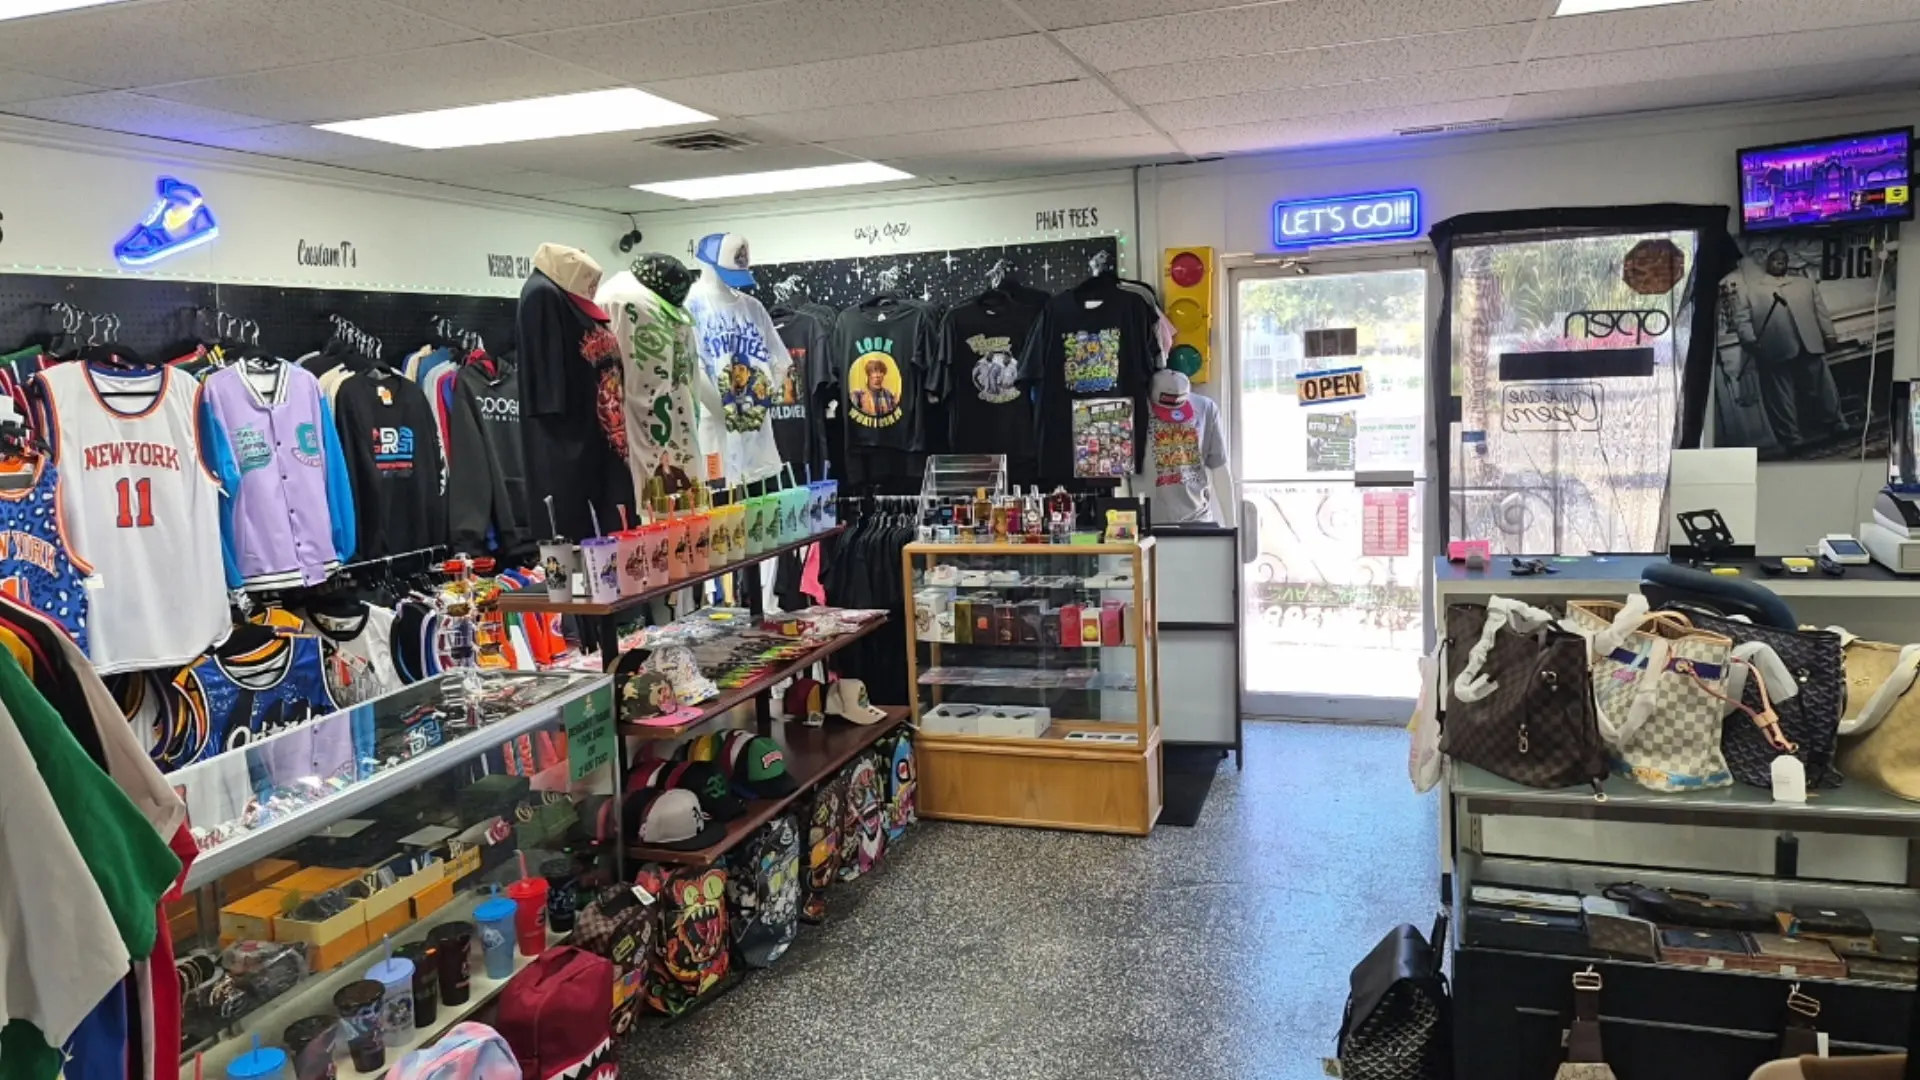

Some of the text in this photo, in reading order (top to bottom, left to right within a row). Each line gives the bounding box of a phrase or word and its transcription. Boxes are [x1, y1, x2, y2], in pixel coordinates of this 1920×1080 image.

[1035, 207, 1099, 231] PHAT TEES
[1281, 200, 1411, 235] LET'S GO!!!
[855, 336, 894, 355] LOOK
[1304, 372, 1361, 400] OPEN
[84, 441, 180, 471] NEW YORK
[115, 477, 155, 528] 11
